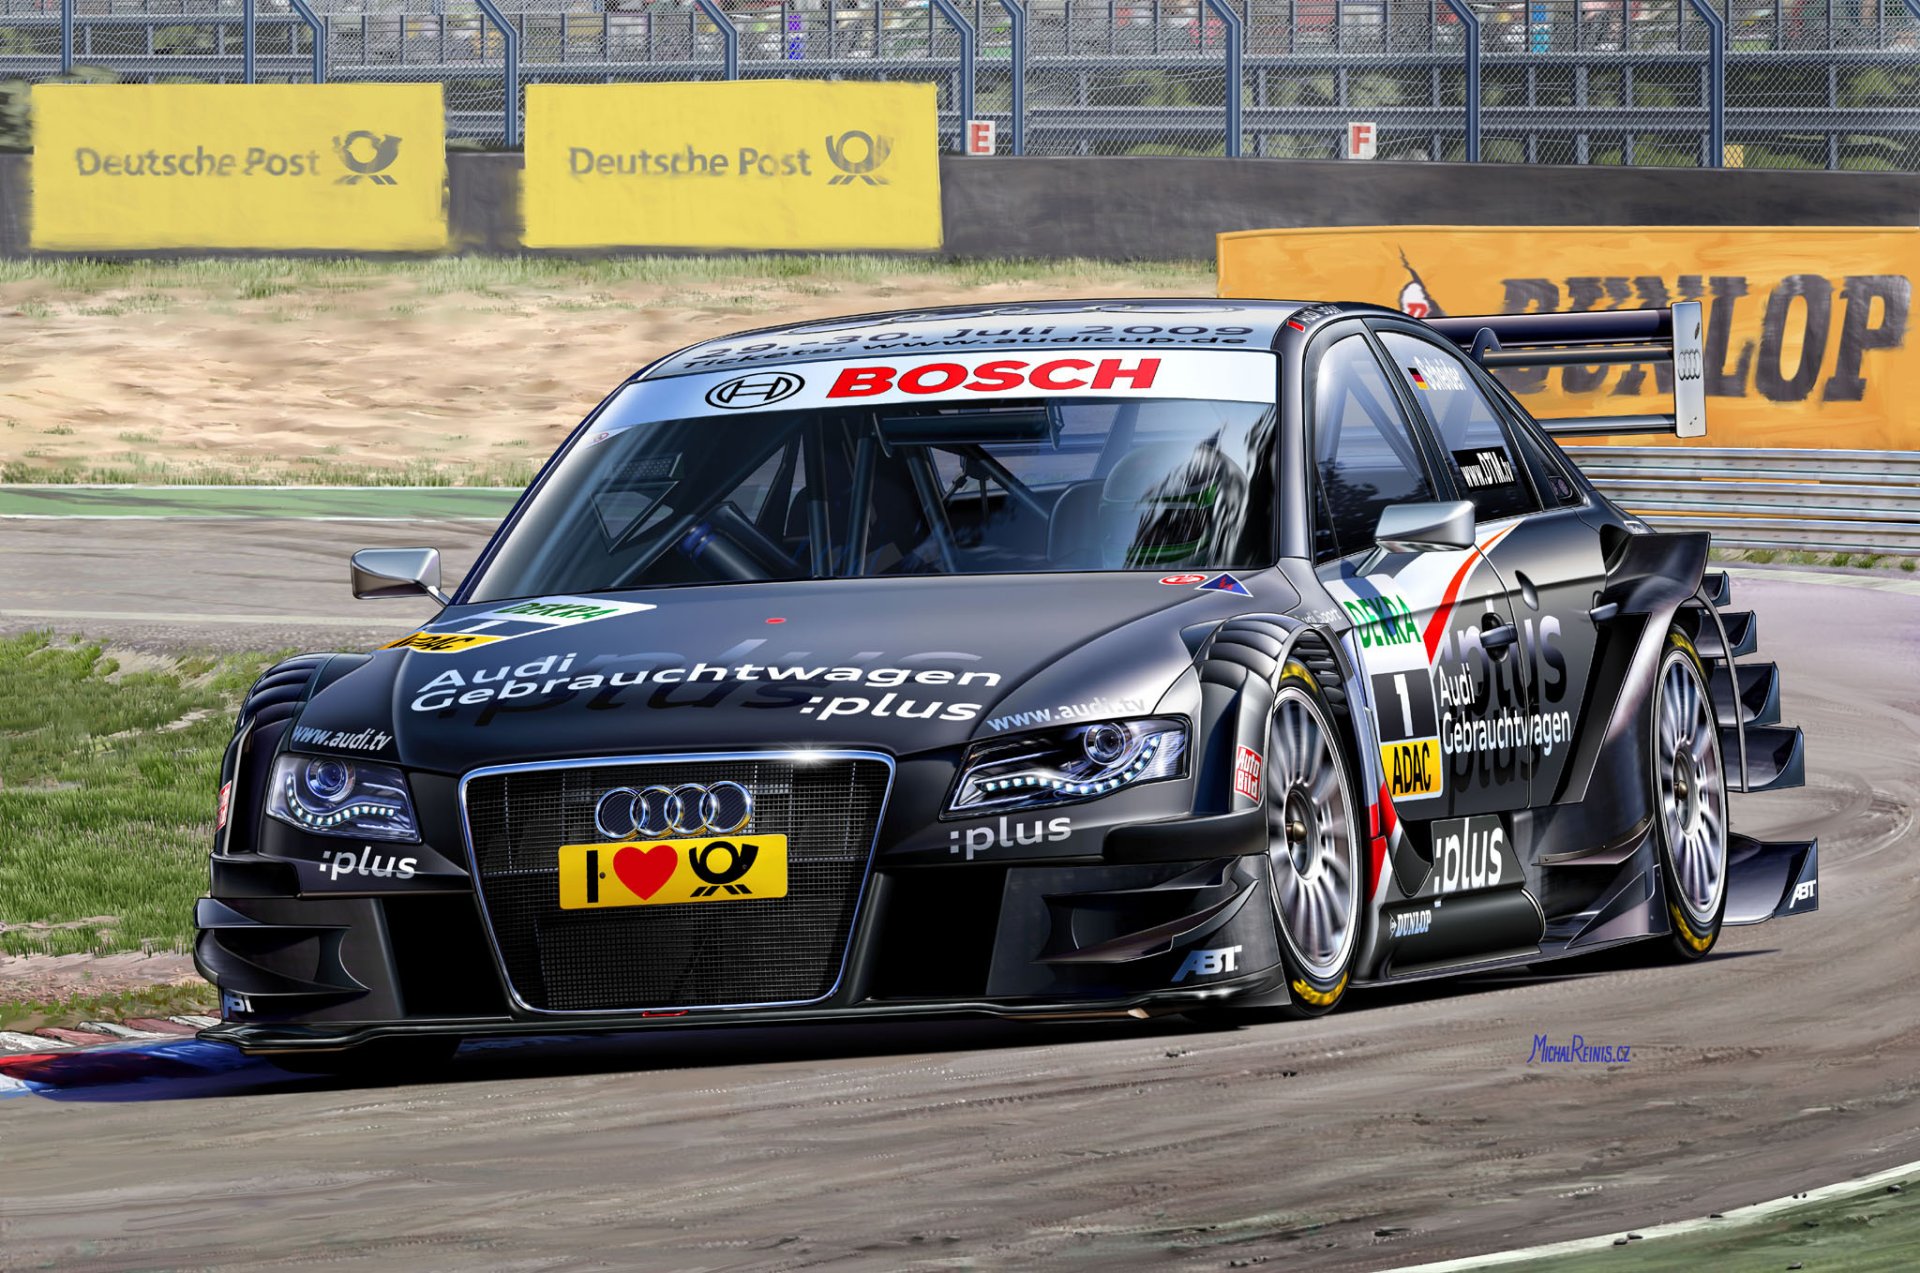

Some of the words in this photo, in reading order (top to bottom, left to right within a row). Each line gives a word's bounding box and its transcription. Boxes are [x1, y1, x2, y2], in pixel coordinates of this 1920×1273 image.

[970, 124, 990, 153] E
[1351, 125, 1371, 155] F
[76, 146, 236, 177] Deutsche
[245, 146, 320, 177] Post
[568, 145, 728, 177] Deutsche
[739, 147, 812, 176] Post
[863, 335, 1247, 350] www.audicup.de
[944, 326, 1057, 338] Juli
[1077, 325, 1254, 336] 2009
[826, 358, 1161, 399] BOSCH
[495, 602, 619, 620] DEKRA
[1343, 594, 1421, 648] DEKRA
[411, 664, 1002, 712] Gebrauchtwagen
[417, 653, 577, 693] Audi
[1439, 663, 1476, 707] Audi
[801, 693, 981, 721] :plus
[987, 697, 1146, 732] www.audi.tv
[1394, 674, 1414, 737] 1
[292, 724, 393, 751] www.audi.tv
[1442, 707, 1571, 756] Gebrauchtwagen
[1238, 747, 1260, 778] Auto
[1392, 742, 1431, 795] ADAC
[1237, 769, 1258, 799] Bild
[950, 815, 1072, 860] :plus
[319, 846, 418, 881] :plus
[586, 850, 599, 903] I
[1789, 879, 1817, 908] ABT
[1395, 910, 1432, 938] DUNLOP
